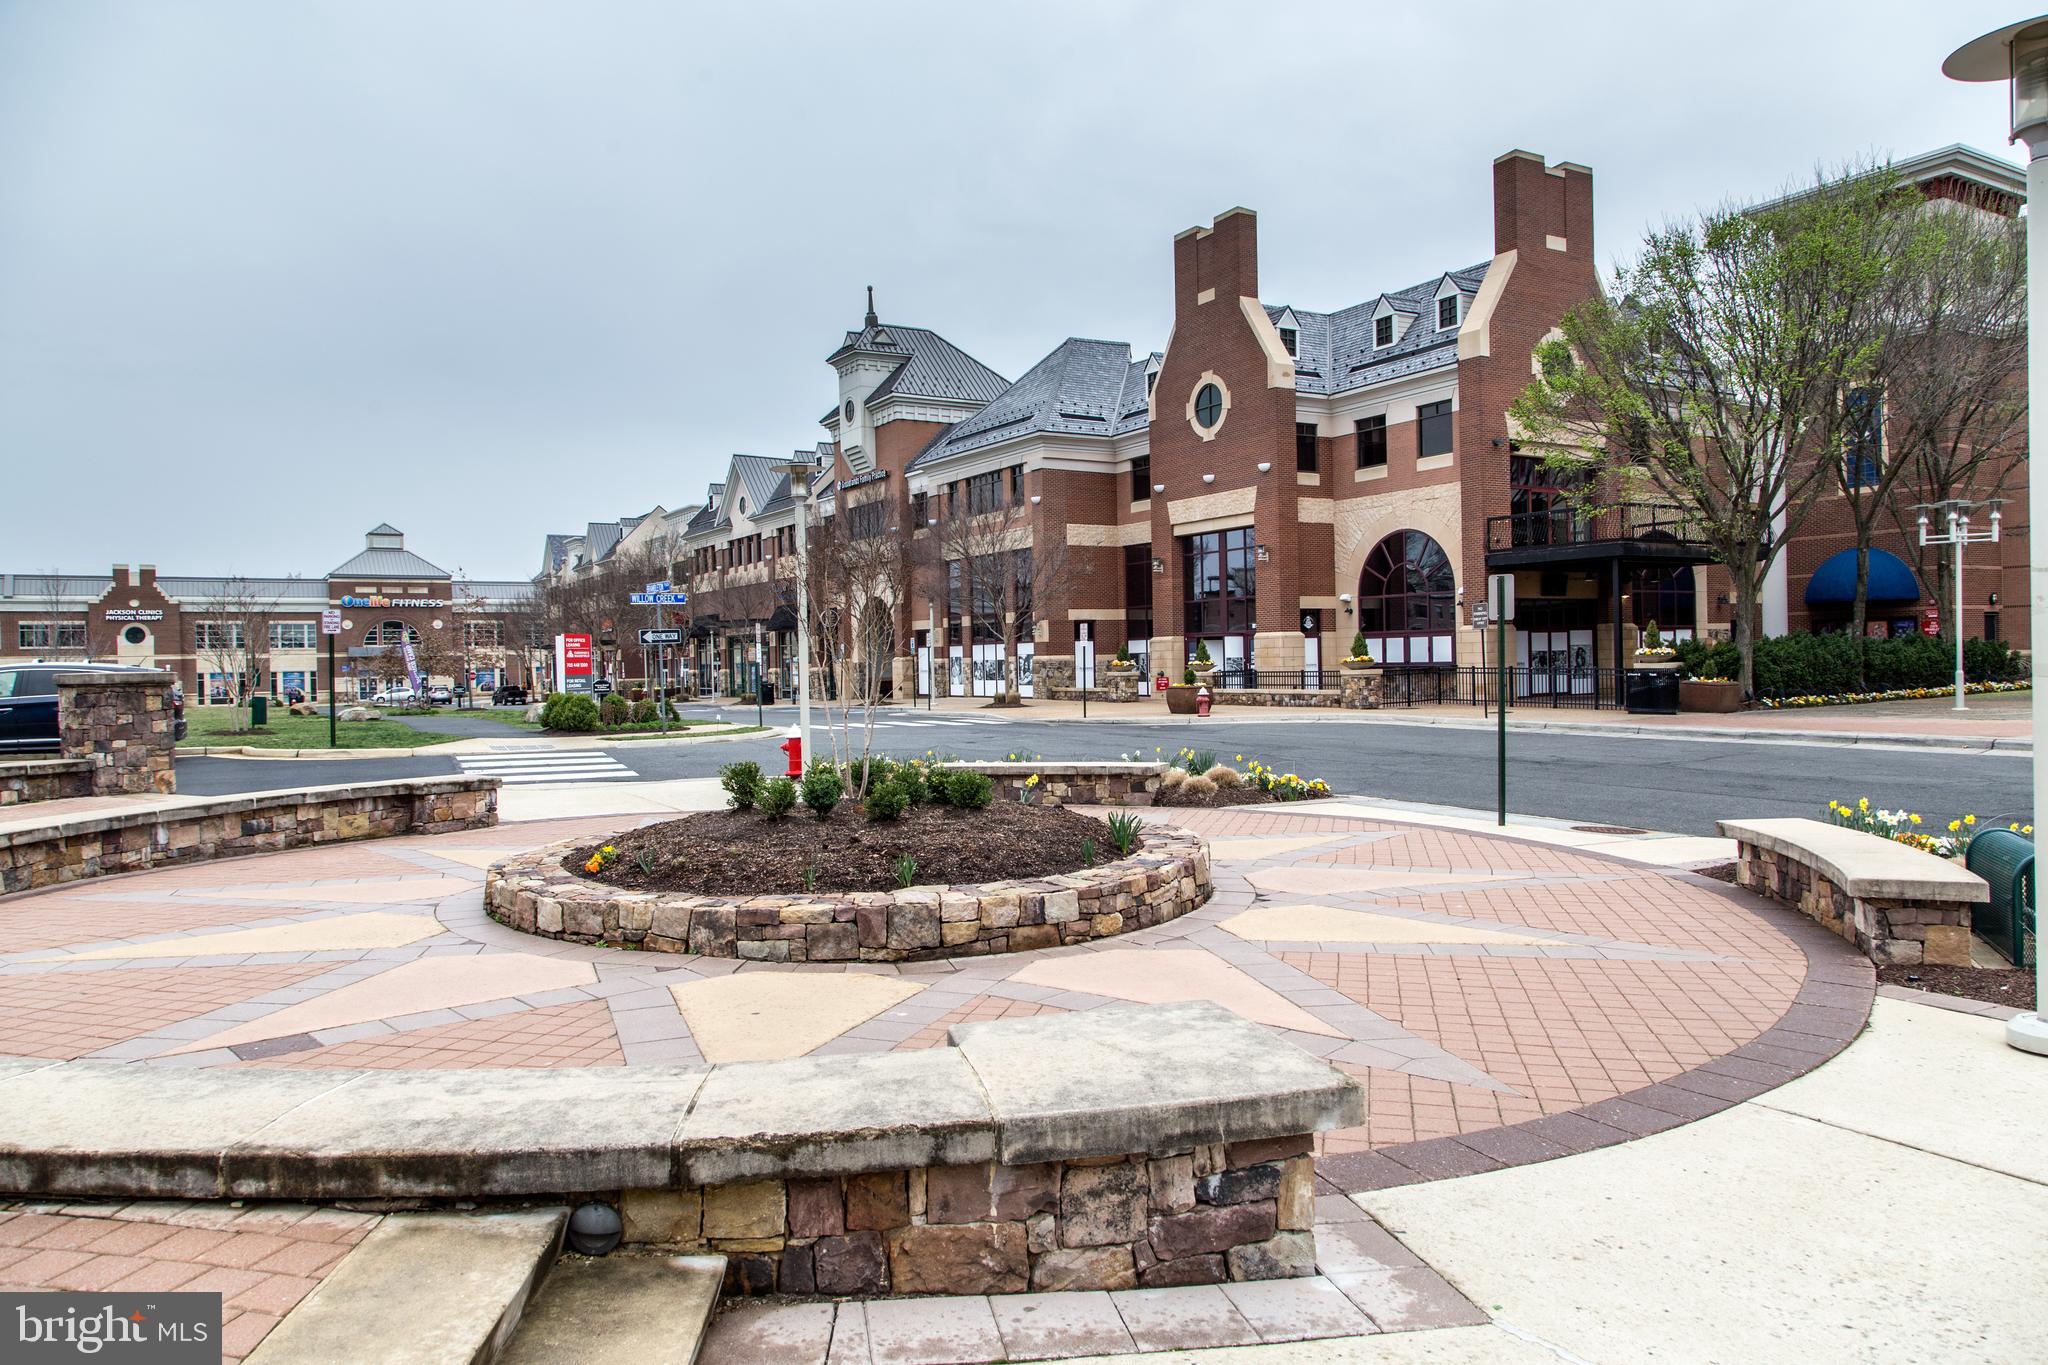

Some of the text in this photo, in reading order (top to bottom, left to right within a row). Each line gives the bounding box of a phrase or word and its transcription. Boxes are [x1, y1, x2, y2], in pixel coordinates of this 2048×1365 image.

[341, 594, 444, 608] Onelife FITNESS
[631, 594, 654, 603] WILLOW
[655, 594, 675, 603] CREEK
